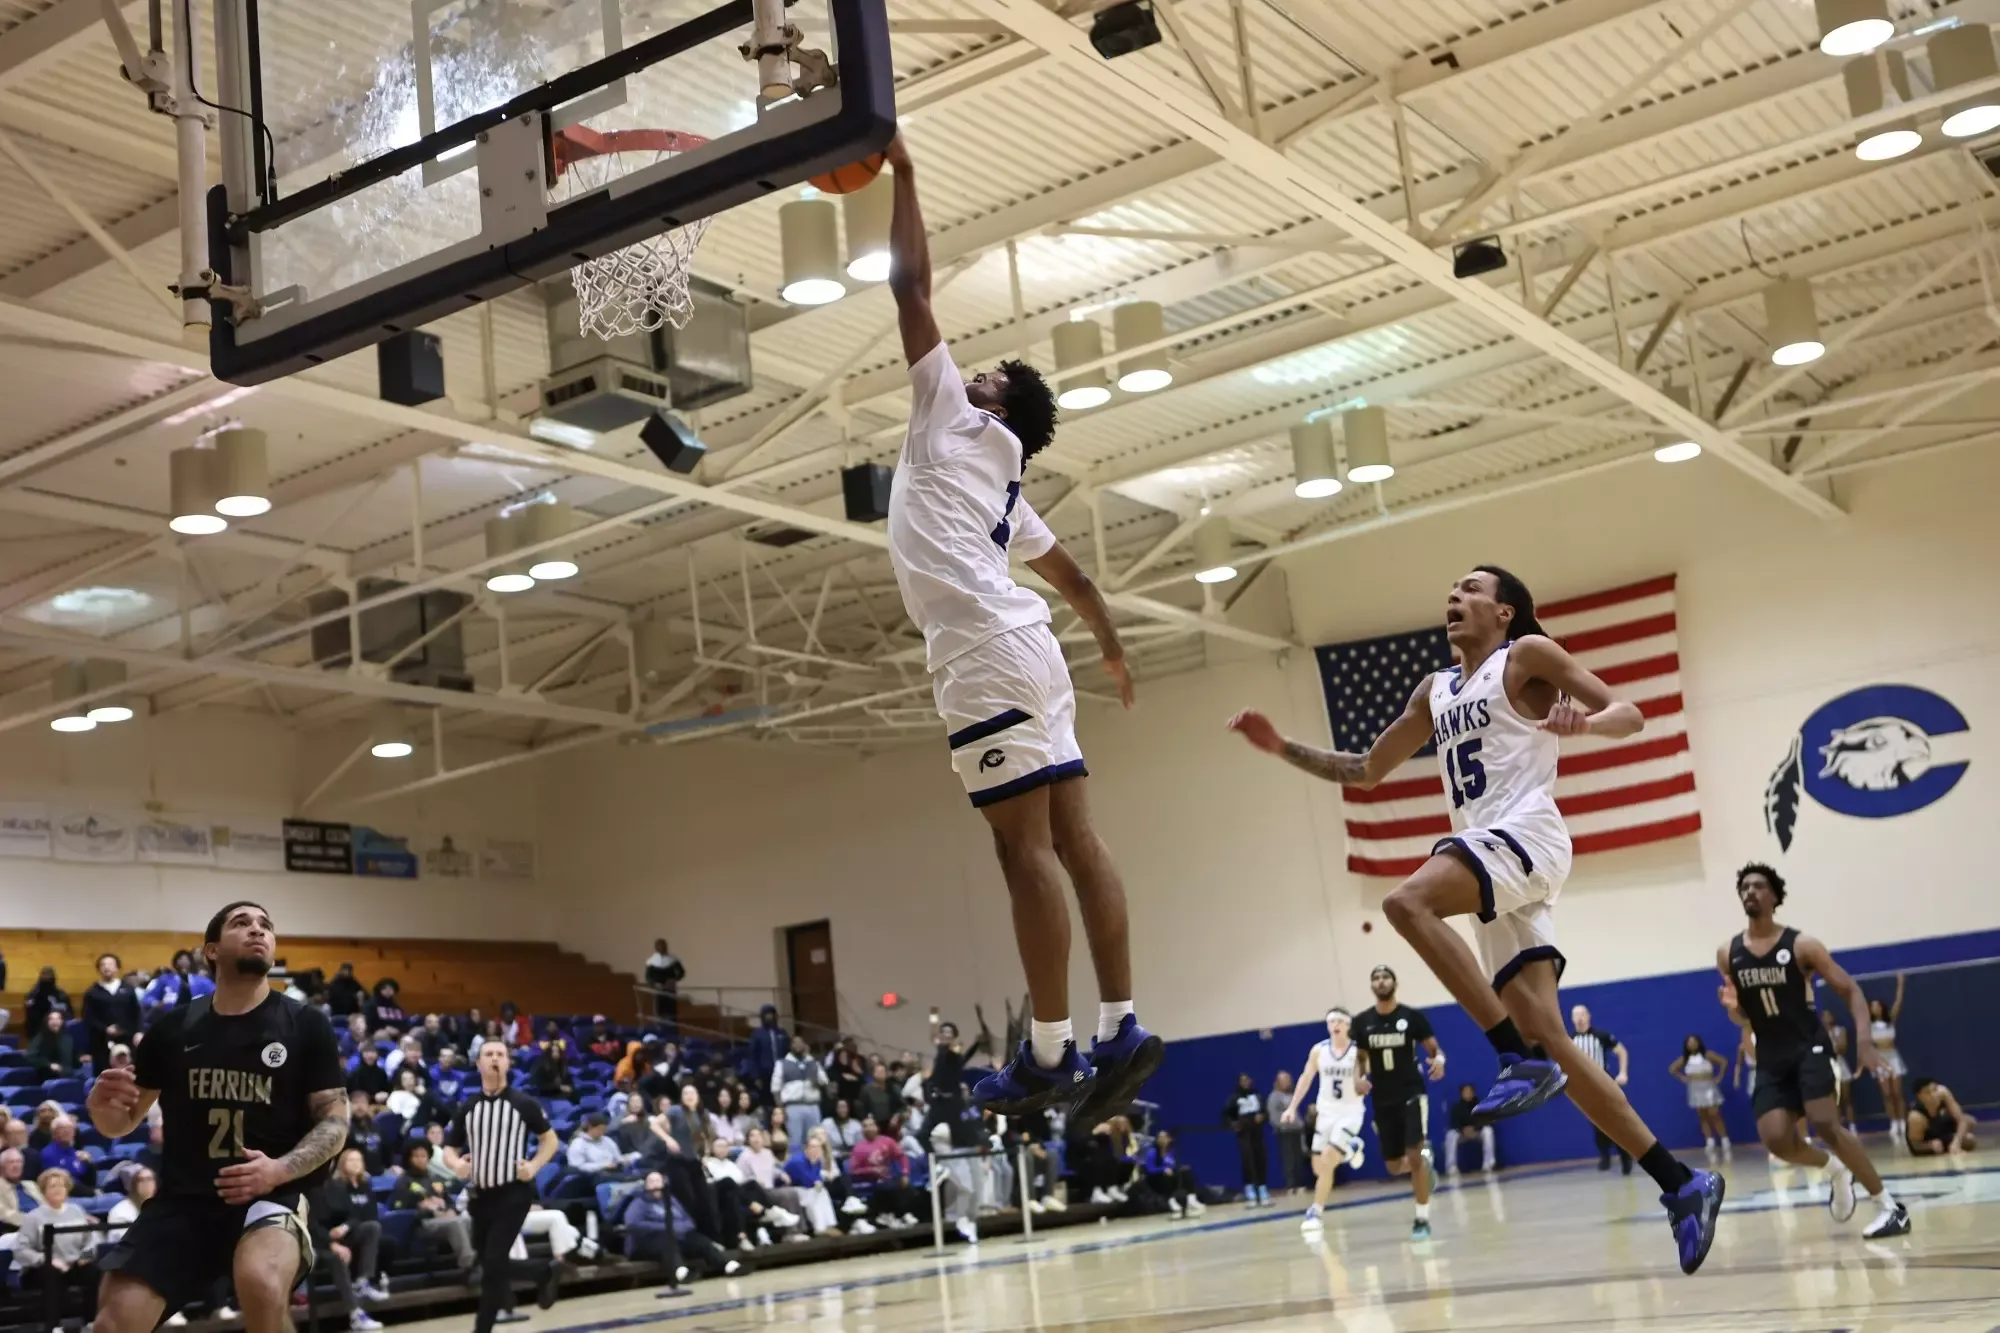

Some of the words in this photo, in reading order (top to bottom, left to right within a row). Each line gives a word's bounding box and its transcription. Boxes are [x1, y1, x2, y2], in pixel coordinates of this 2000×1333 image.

[1434, 698, 1491, 745] HAWKS
[1446, 737, 1487, 809] 15
[1760, 986, 1780, 1017] 11
[188, 1067, 273, 1105] FERRUM
[1332, 1079, 1343, 1100] 5
[208, 1107, 245, 1159] 21
